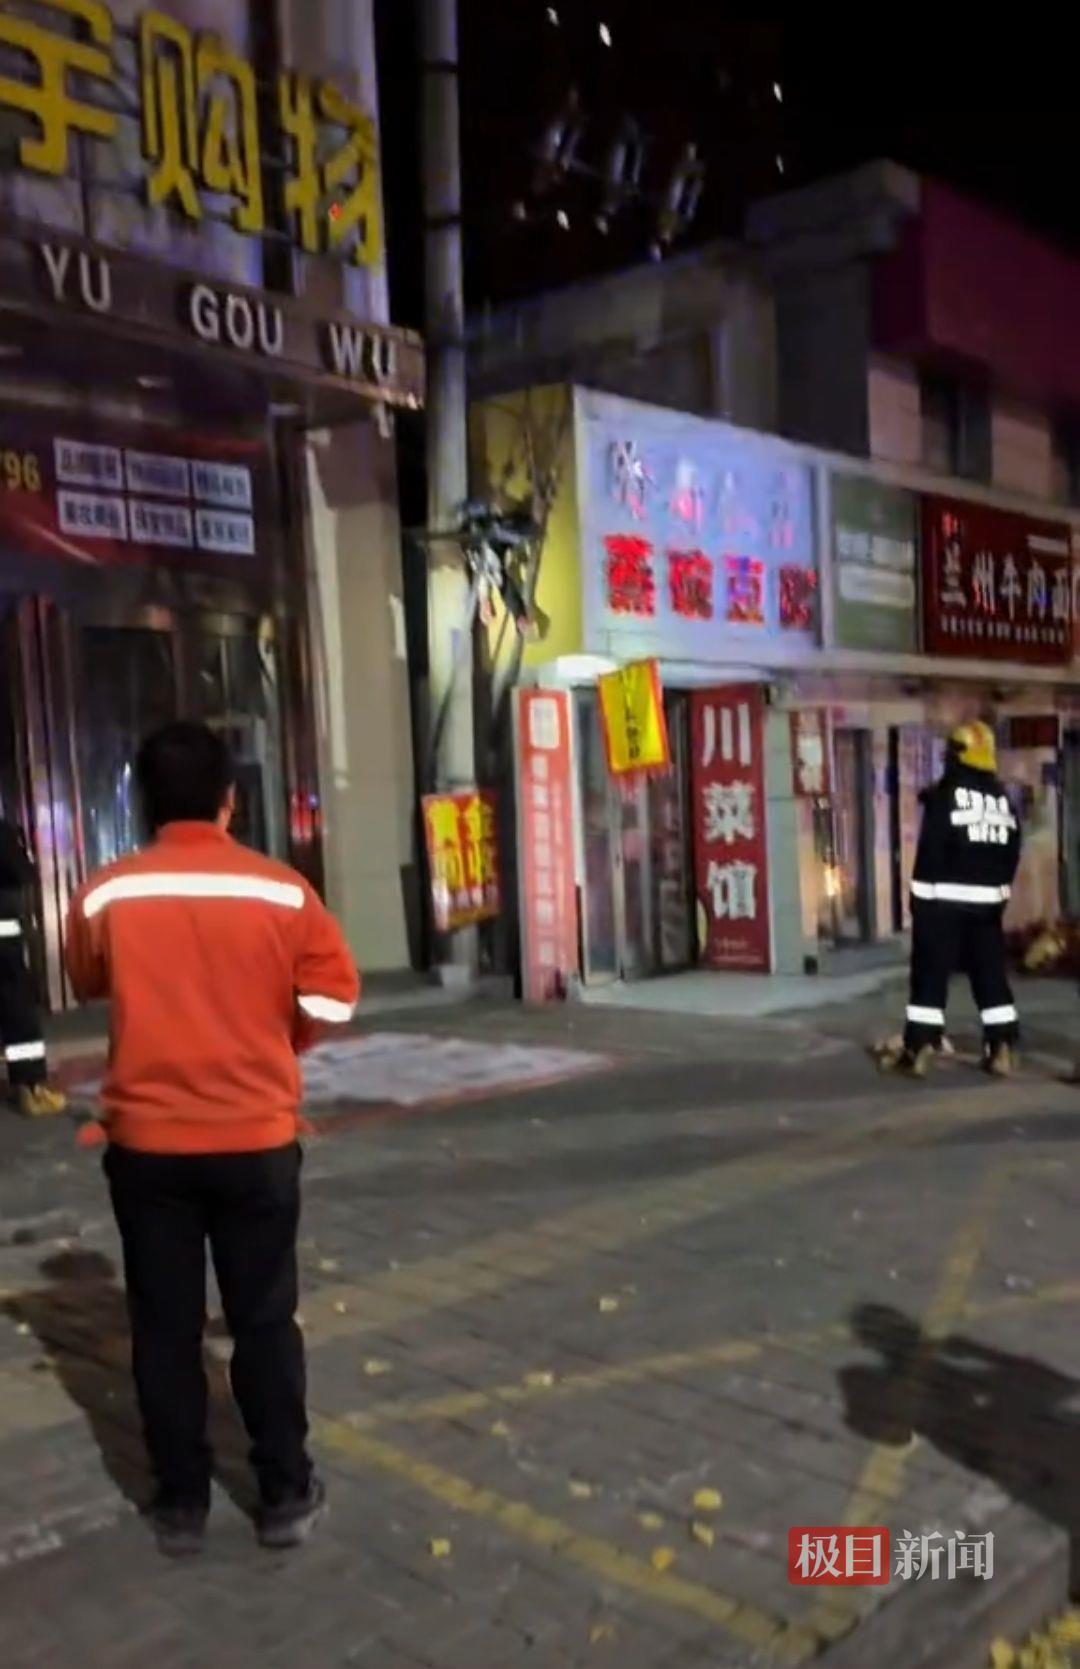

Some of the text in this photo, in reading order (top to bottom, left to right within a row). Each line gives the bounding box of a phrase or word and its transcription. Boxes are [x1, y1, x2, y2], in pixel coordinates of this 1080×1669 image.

[42, 244, 398, 383] YU GOU WU
[702, 703, 757, 920] 川菜馆
